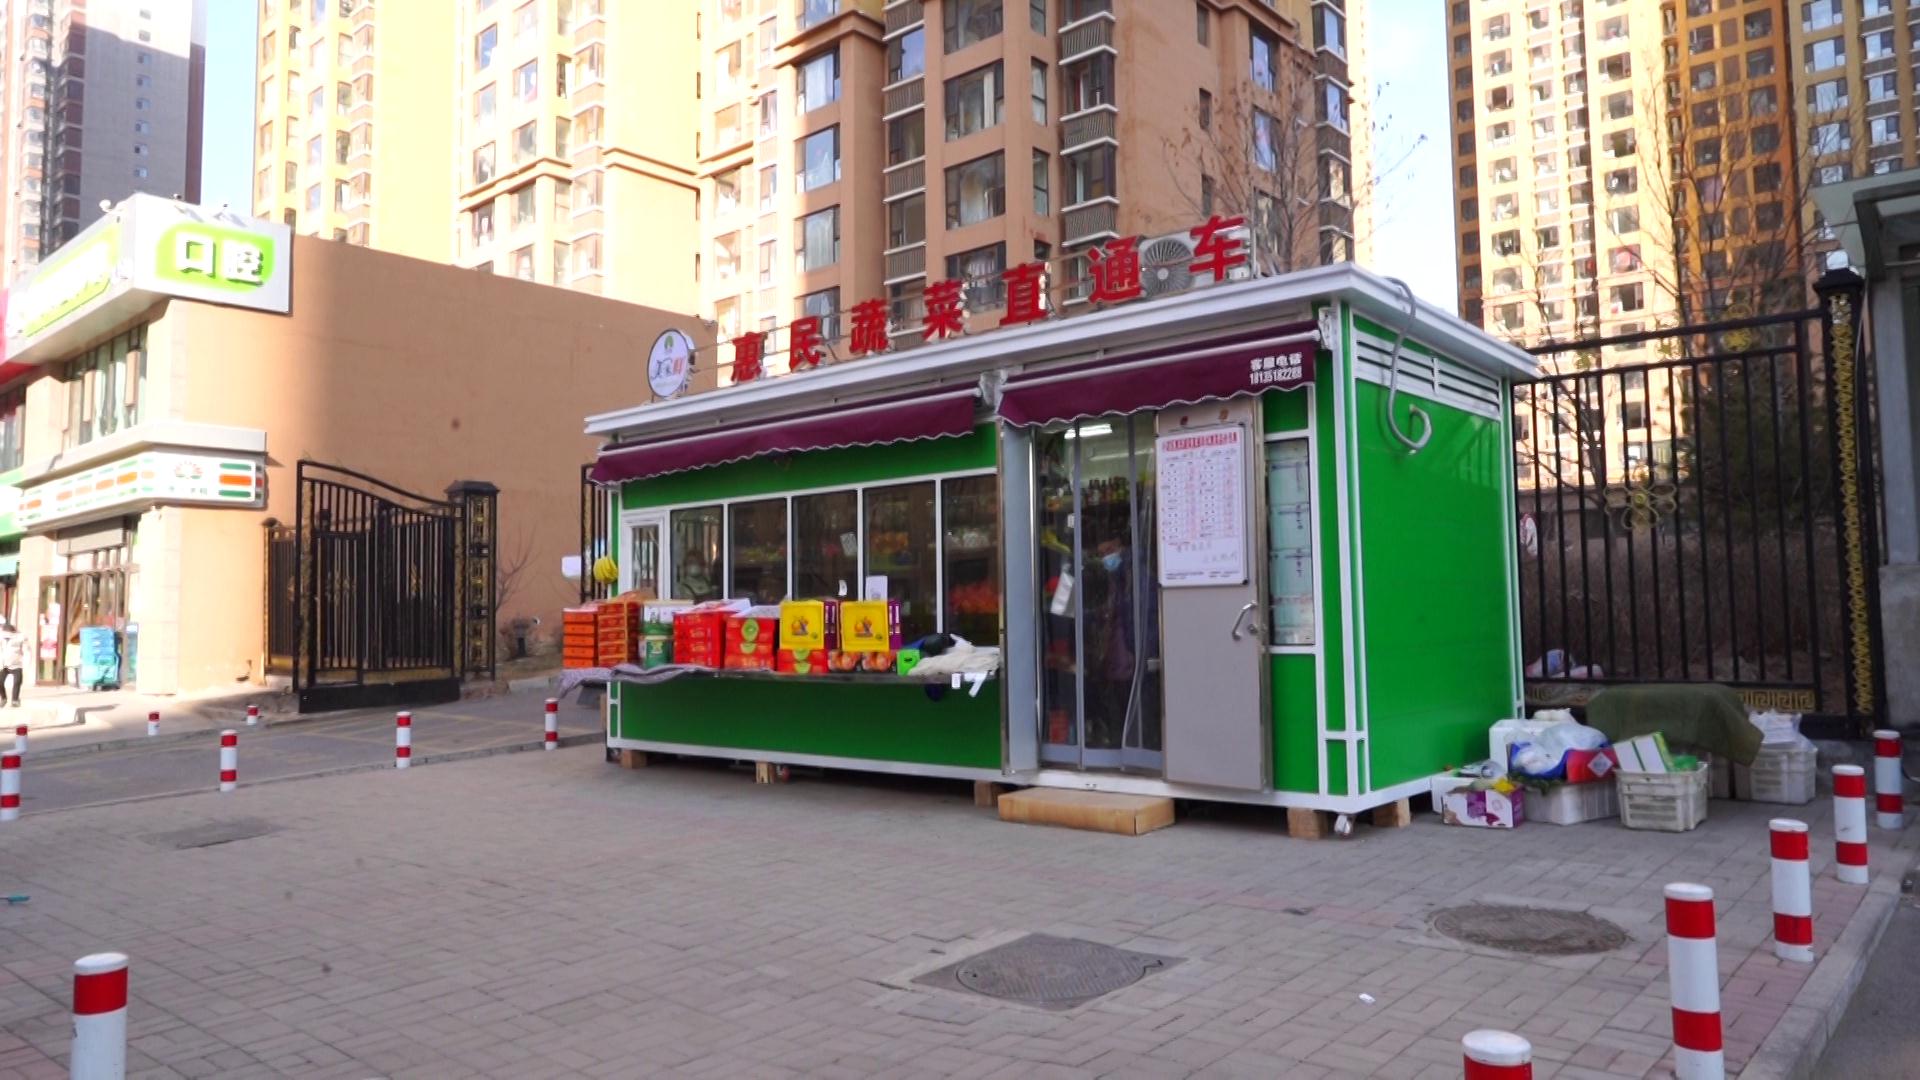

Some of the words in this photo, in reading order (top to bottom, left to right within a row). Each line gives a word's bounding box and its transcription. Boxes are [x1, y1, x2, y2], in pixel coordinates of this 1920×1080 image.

[730, 215, 1248, 383] 惠民蔬菜直通车
